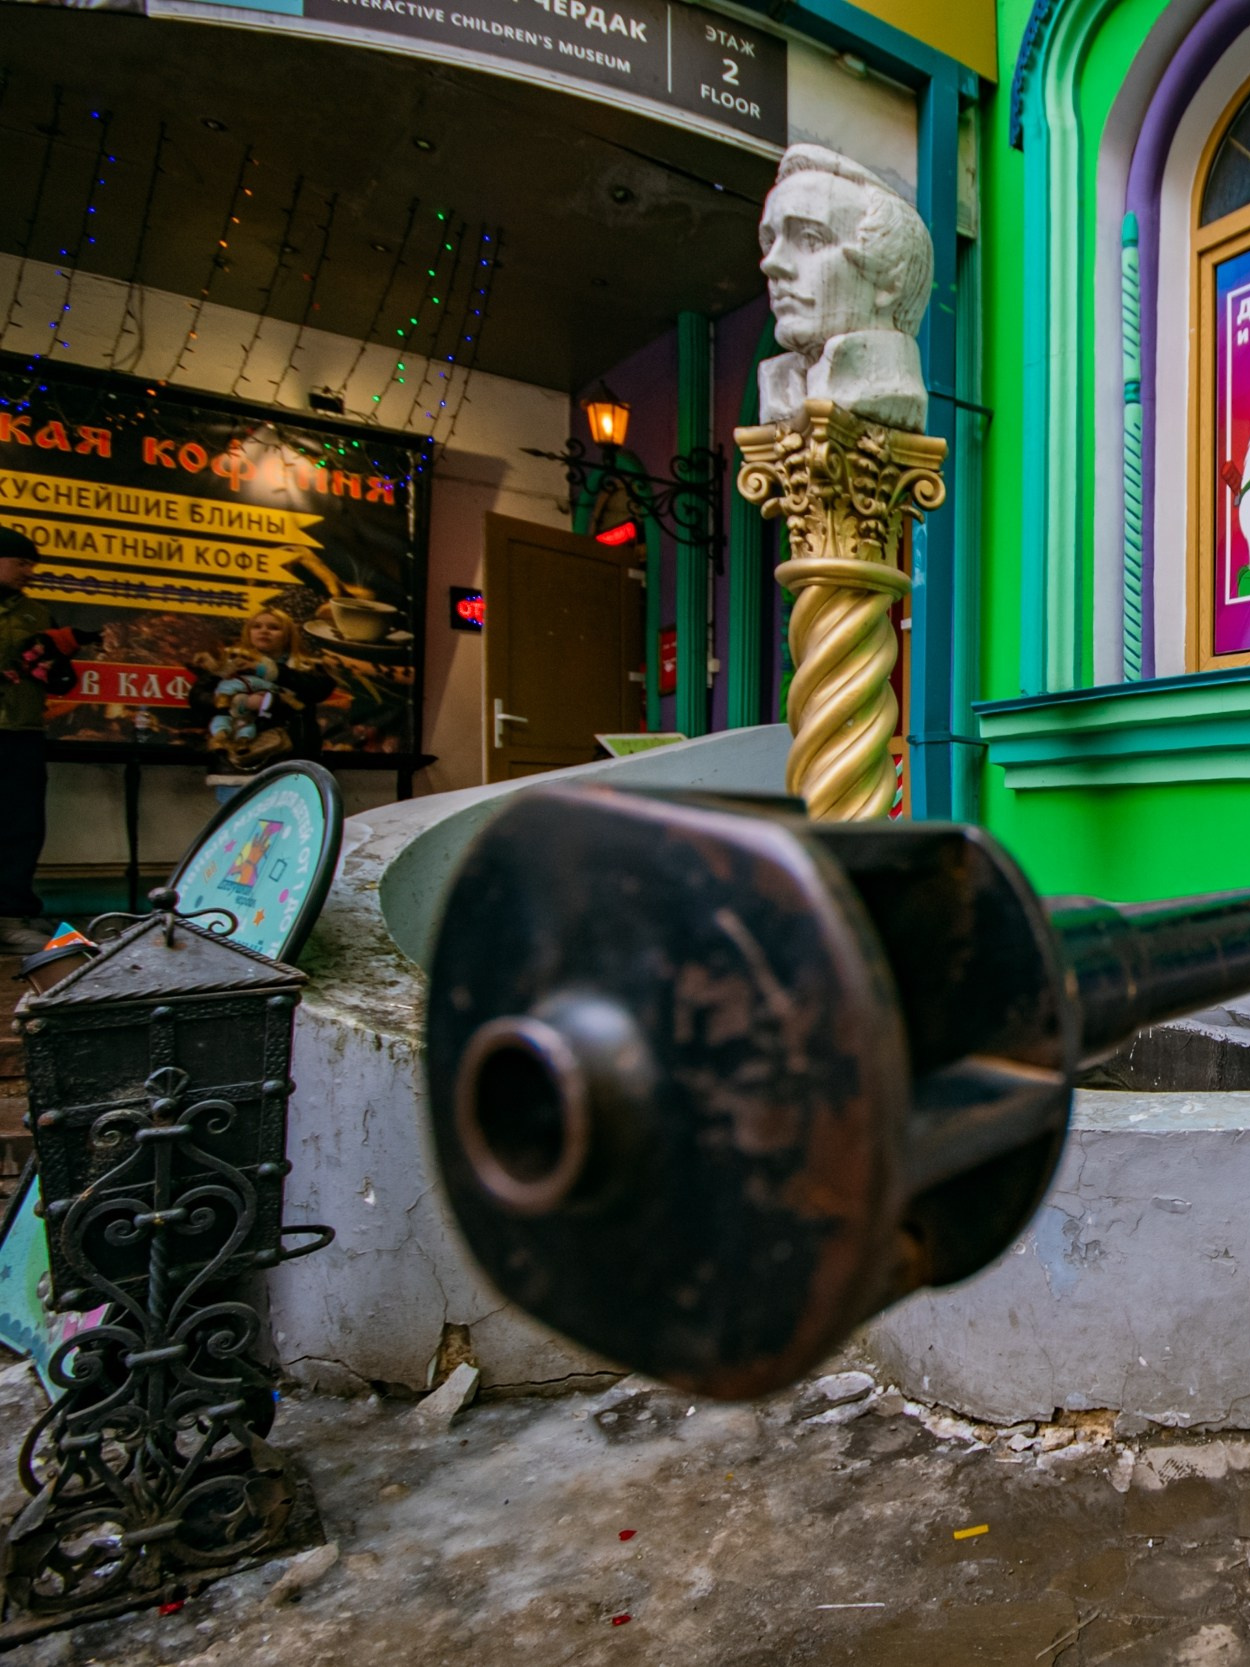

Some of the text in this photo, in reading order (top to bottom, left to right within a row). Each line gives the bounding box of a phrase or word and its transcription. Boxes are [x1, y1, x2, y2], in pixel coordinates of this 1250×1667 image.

[450, 12, 553, 50] CHILDREN'S
[558, 39, 632, 74] MUSEUM
[704, 24, 756, 58] ЭТАЖ
[721, 59, 740, 86] 2
[700, 84, 762, 120] FLOOR
[1237, 328, 1249, 346] и
[190, 502, 285, 535] БЛИНЫ
[194, 548, 269, 574] КОФЕ
